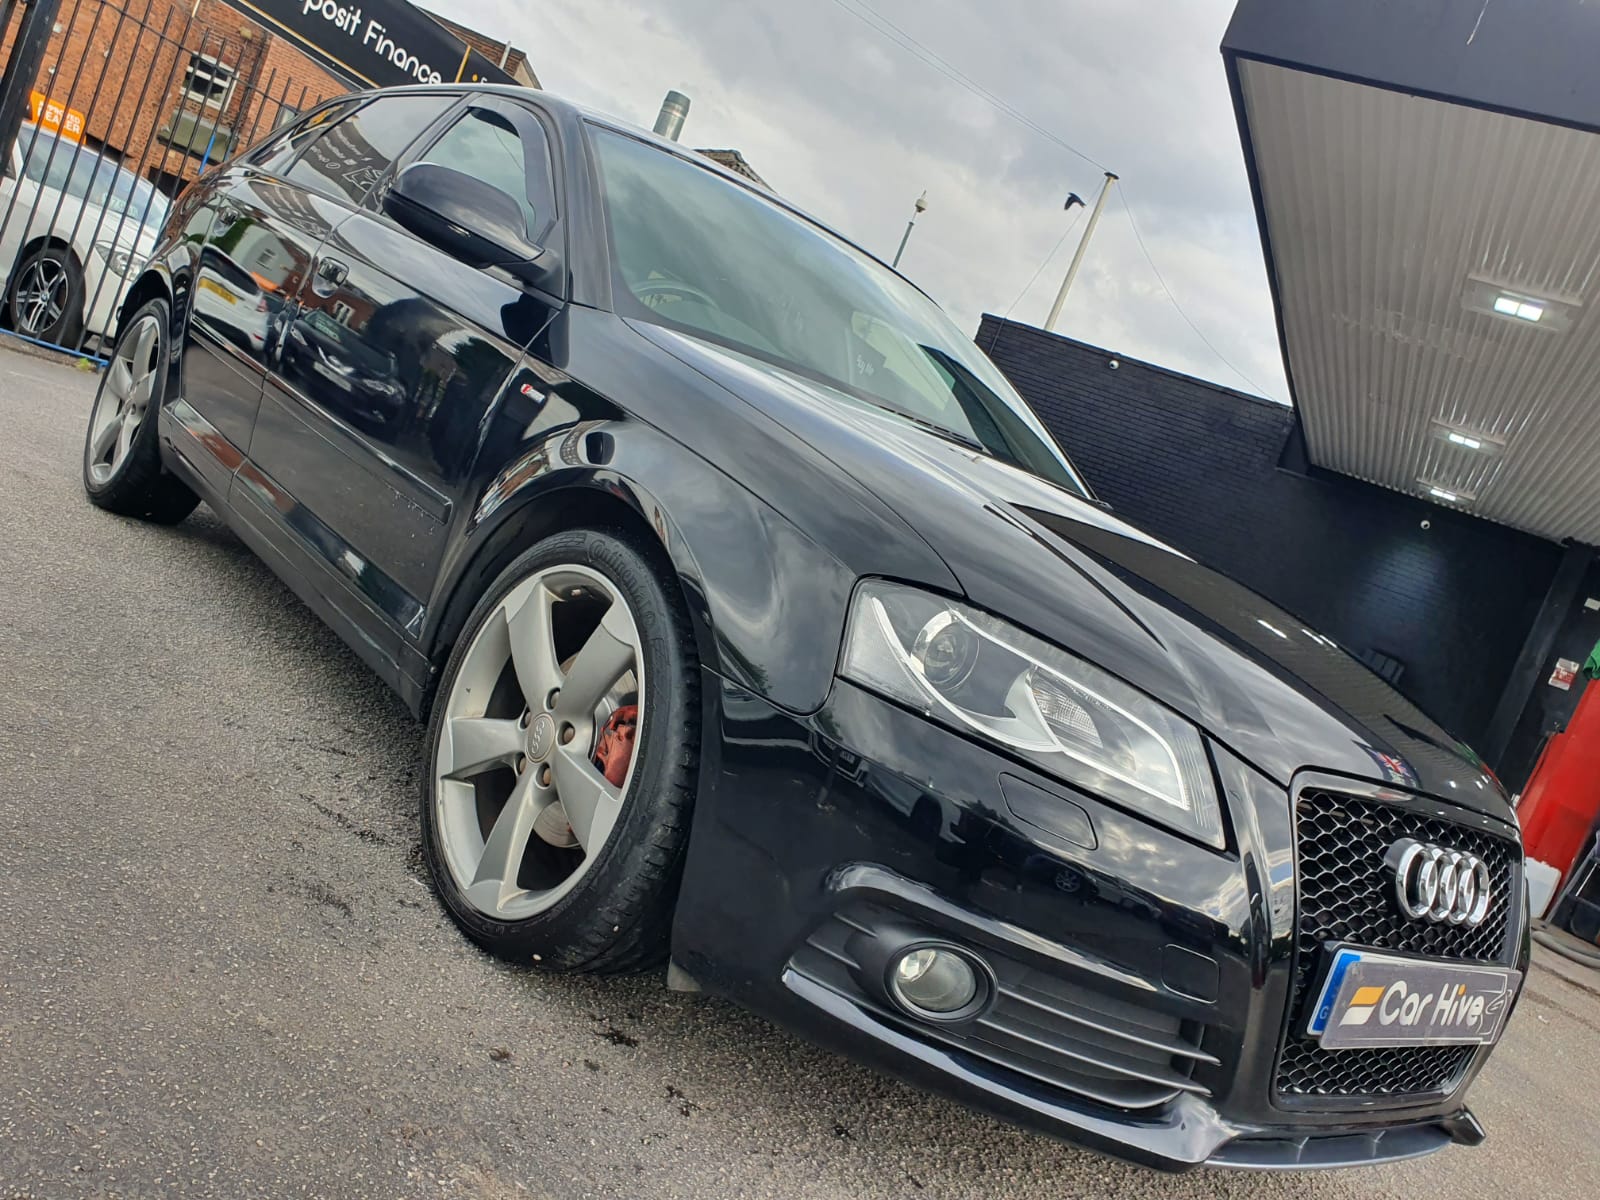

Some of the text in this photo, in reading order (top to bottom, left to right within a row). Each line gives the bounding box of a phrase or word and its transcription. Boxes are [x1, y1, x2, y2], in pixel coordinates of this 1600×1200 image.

[363, 20, 442, 84] Finance
[37, 107, 80, 135] EAER
[1379, 980, 1485, 1027] Car Hive
